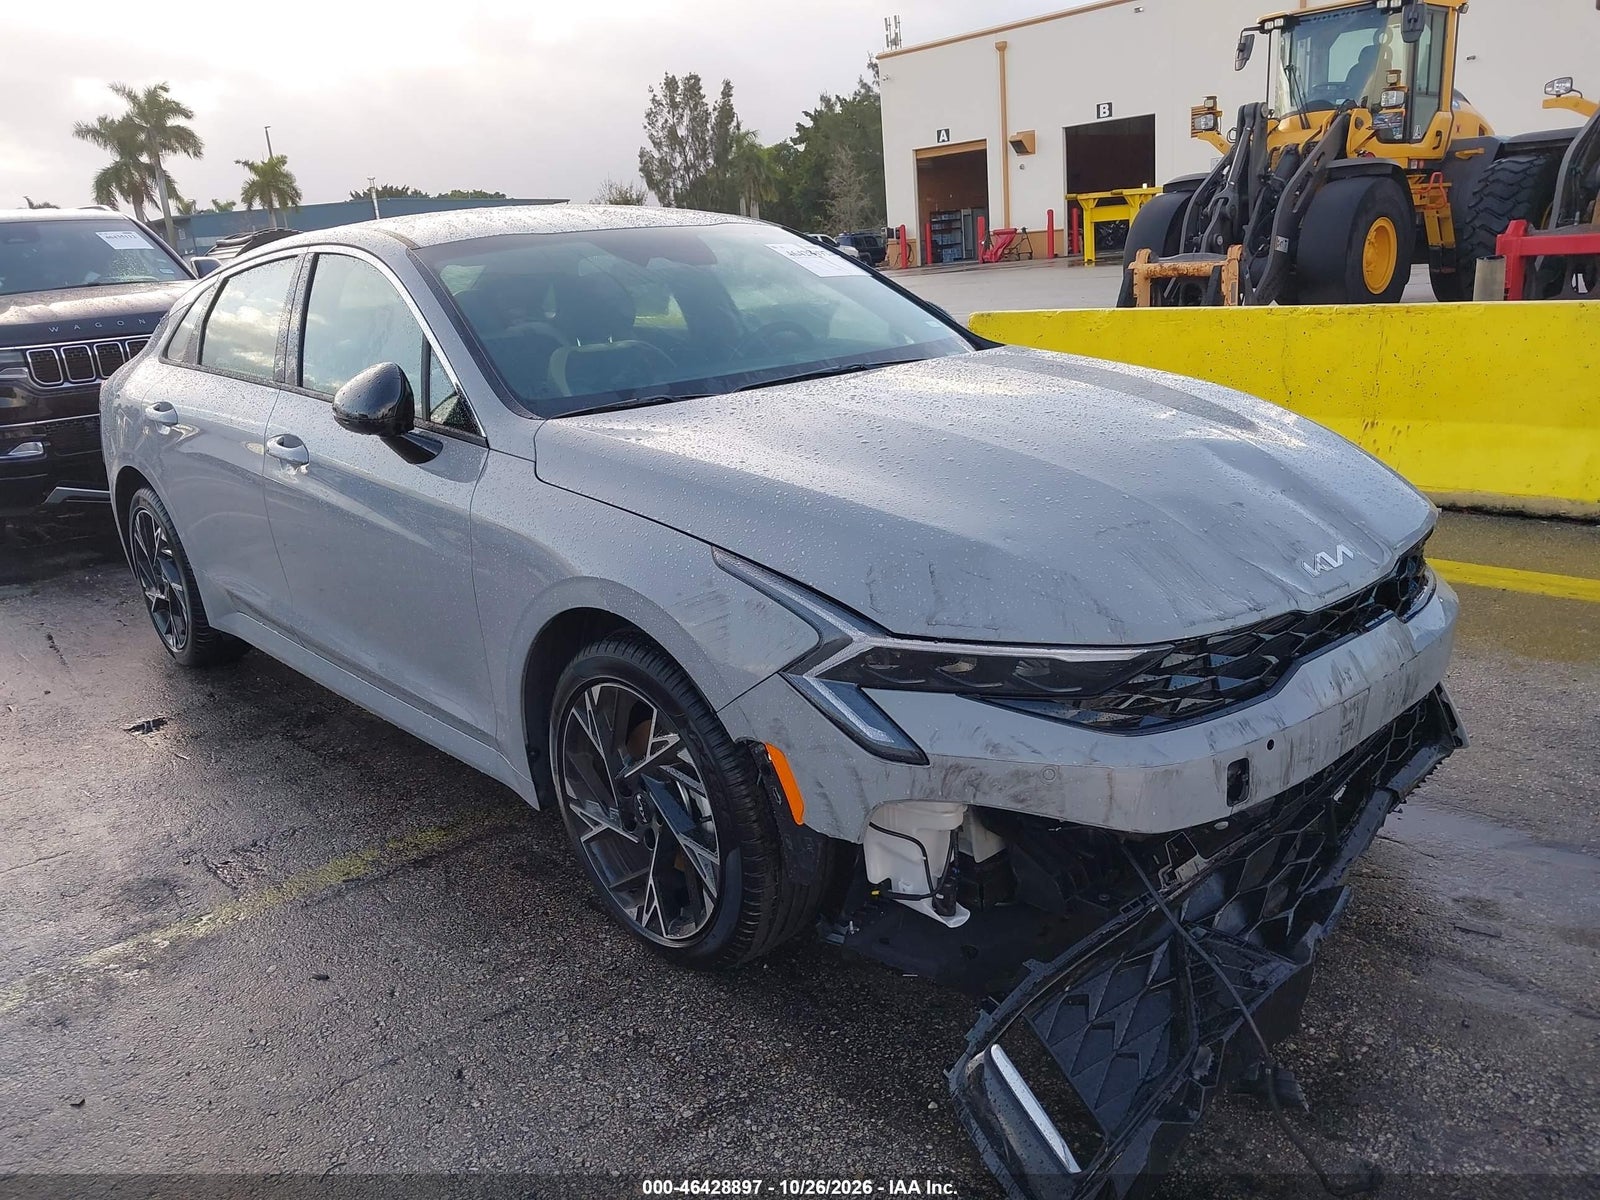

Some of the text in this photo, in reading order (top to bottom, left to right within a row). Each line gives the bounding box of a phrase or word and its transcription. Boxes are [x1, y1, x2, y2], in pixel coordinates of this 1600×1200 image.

[1099, 104, 1110, 118] B
[938, 129, 948, 142] A
[49, 317, 158, 333] WAGON
[1302, 544, 1354, 578] KIA
